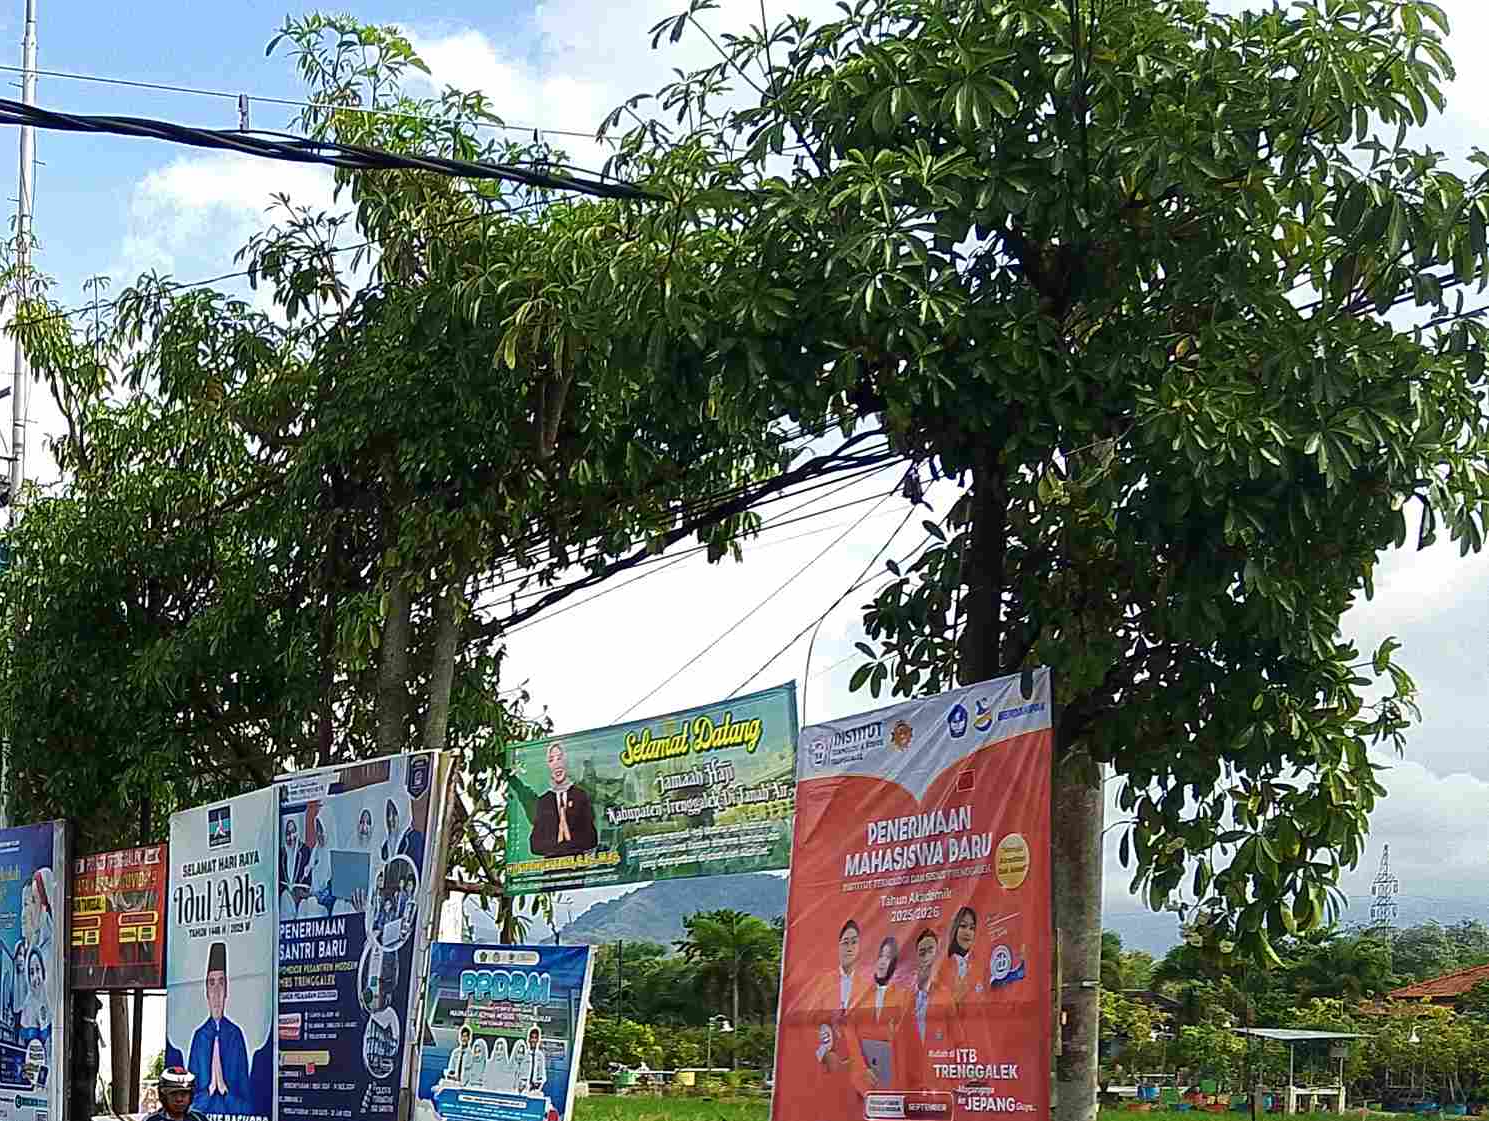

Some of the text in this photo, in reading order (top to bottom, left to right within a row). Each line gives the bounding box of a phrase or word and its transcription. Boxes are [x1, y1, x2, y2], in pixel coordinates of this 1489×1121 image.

[622, 713, 761, 766] Selamat Datang
[831, 721, 883, 746] INSTITUT
[705, 758, 736, 787] Haji
[607, 804, 661, 825] Kabupaten
[867, 804, 972, 846] PENERIMAAN
[182, 859, 217, 878] SELAMAT
[218, 855, 238, 871] HARI
[238, 850, 260, 868] RAYA
[844, 840, 944, 878] MAHASISWA
[948, 832, 994, 862] BARU
[173, 872, 266, 925] Idul Adha
[279, 918, 346, 940] PENERIMAAN
[279, 939, 347, 961] SANTRI BARU
[460, 969, 551, 1002] PPDBM
[956, 1049, 978, 1063] ITB
[933, 1064, 1019, 1080] TRENGGALEK
[965, 1097, 1016, 1112] JEPANG
